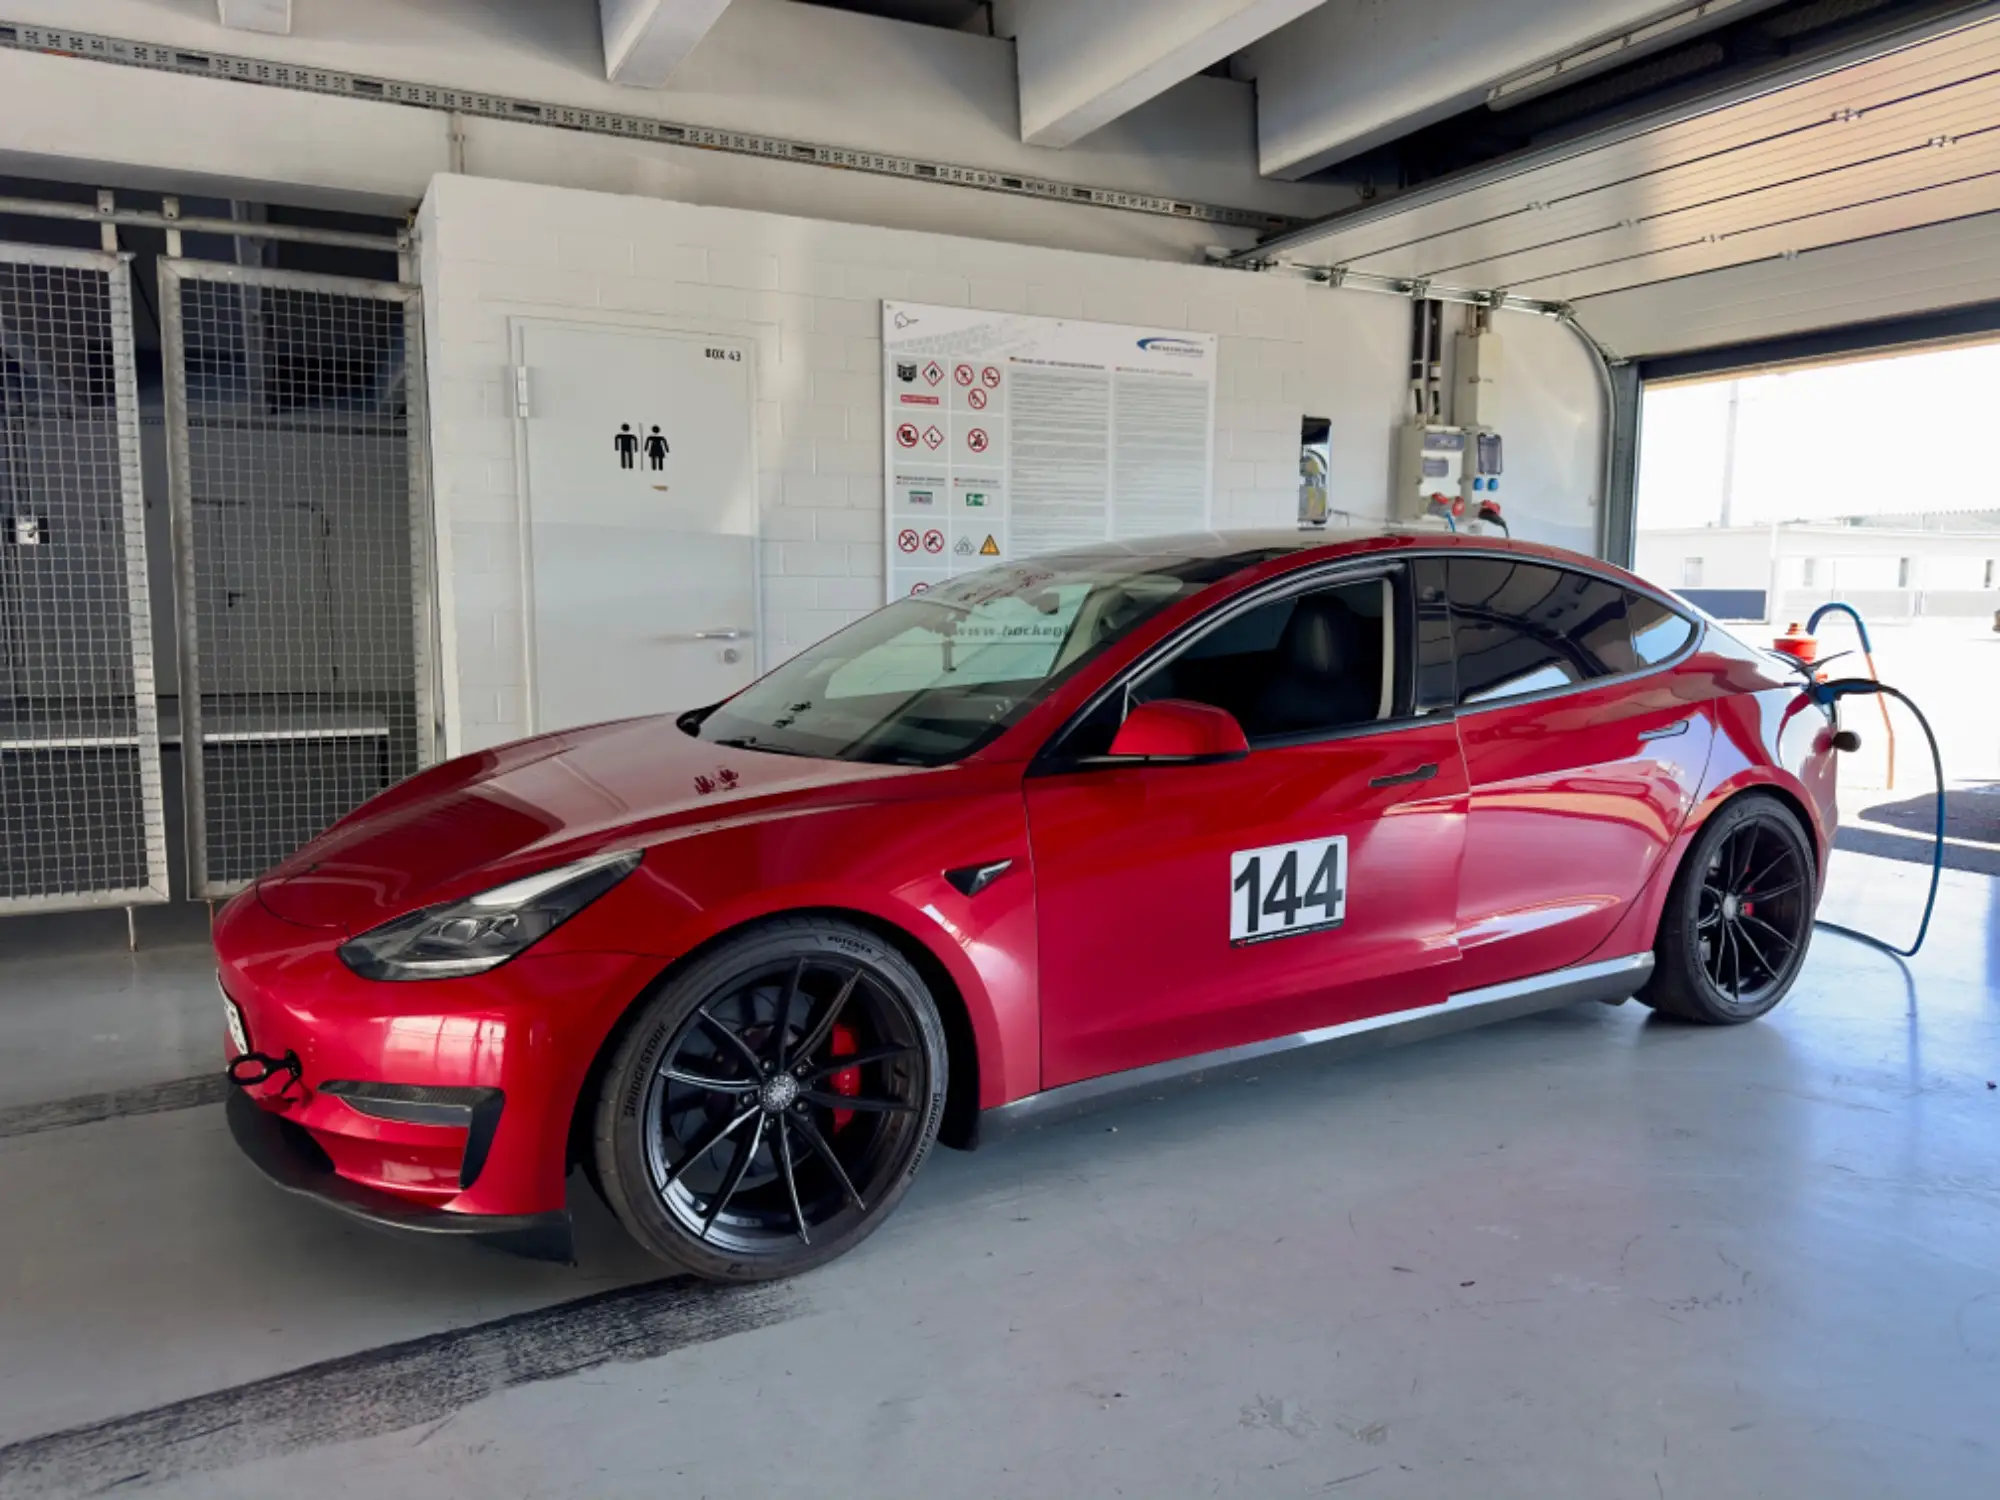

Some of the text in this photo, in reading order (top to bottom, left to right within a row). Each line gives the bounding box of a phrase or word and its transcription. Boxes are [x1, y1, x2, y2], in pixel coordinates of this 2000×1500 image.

[705, 348, 741, 362] BOX 43
[1234, 843, 1343, 933] 144
[624, 1021, 669, 1118] BRIDGESTONE
